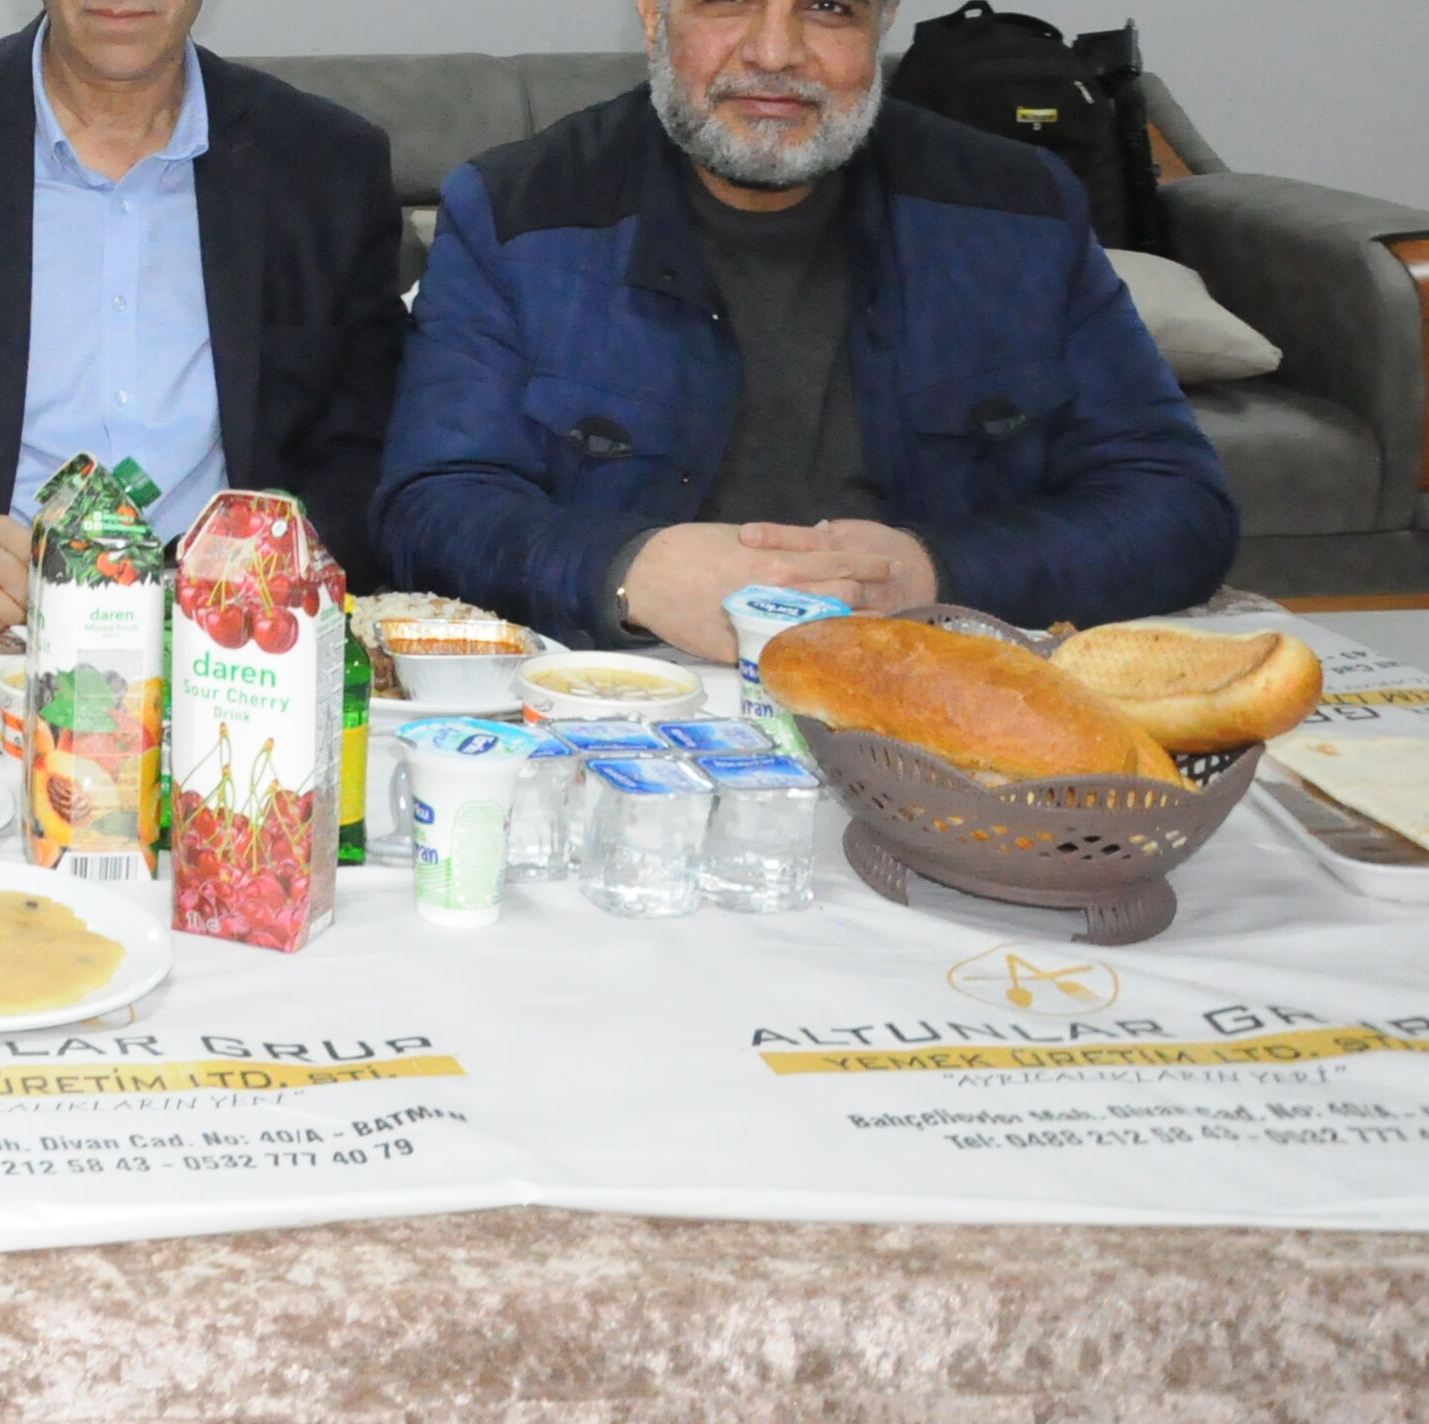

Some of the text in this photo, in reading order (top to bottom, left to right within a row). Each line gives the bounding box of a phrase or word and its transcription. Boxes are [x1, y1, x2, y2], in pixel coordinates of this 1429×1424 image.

[89, 607, 135, 621] daren
[193, 650, 277, 687] daren
[183, 679, 290, 713] Sour Cherry
[213, 705, 251, 722] Drink
[751, 1020, 1176, 1047] ALTUNLAR
[200, 1035, 434, 1063] GRUP
[823, 1050, 993, 1072] YEMEK
[40, 1135, 120, 1152] Divan
[128, 1132, 195, 1149] Cad.
[201, 1131, 249, 1148] No:
[259, 1128, 324, 1146] 40/A
[1, 1160, 58, 1176] 212
[67, 1158, 104, 1174] 58
[116, 1156, 152, 1173] 43
[183, 1153, 259, 1171] 0532
[264, 1151, 318, 1168] 777
[331, 1148, 368, 1166] 40
[374, 1137, 415, 1161] 79
